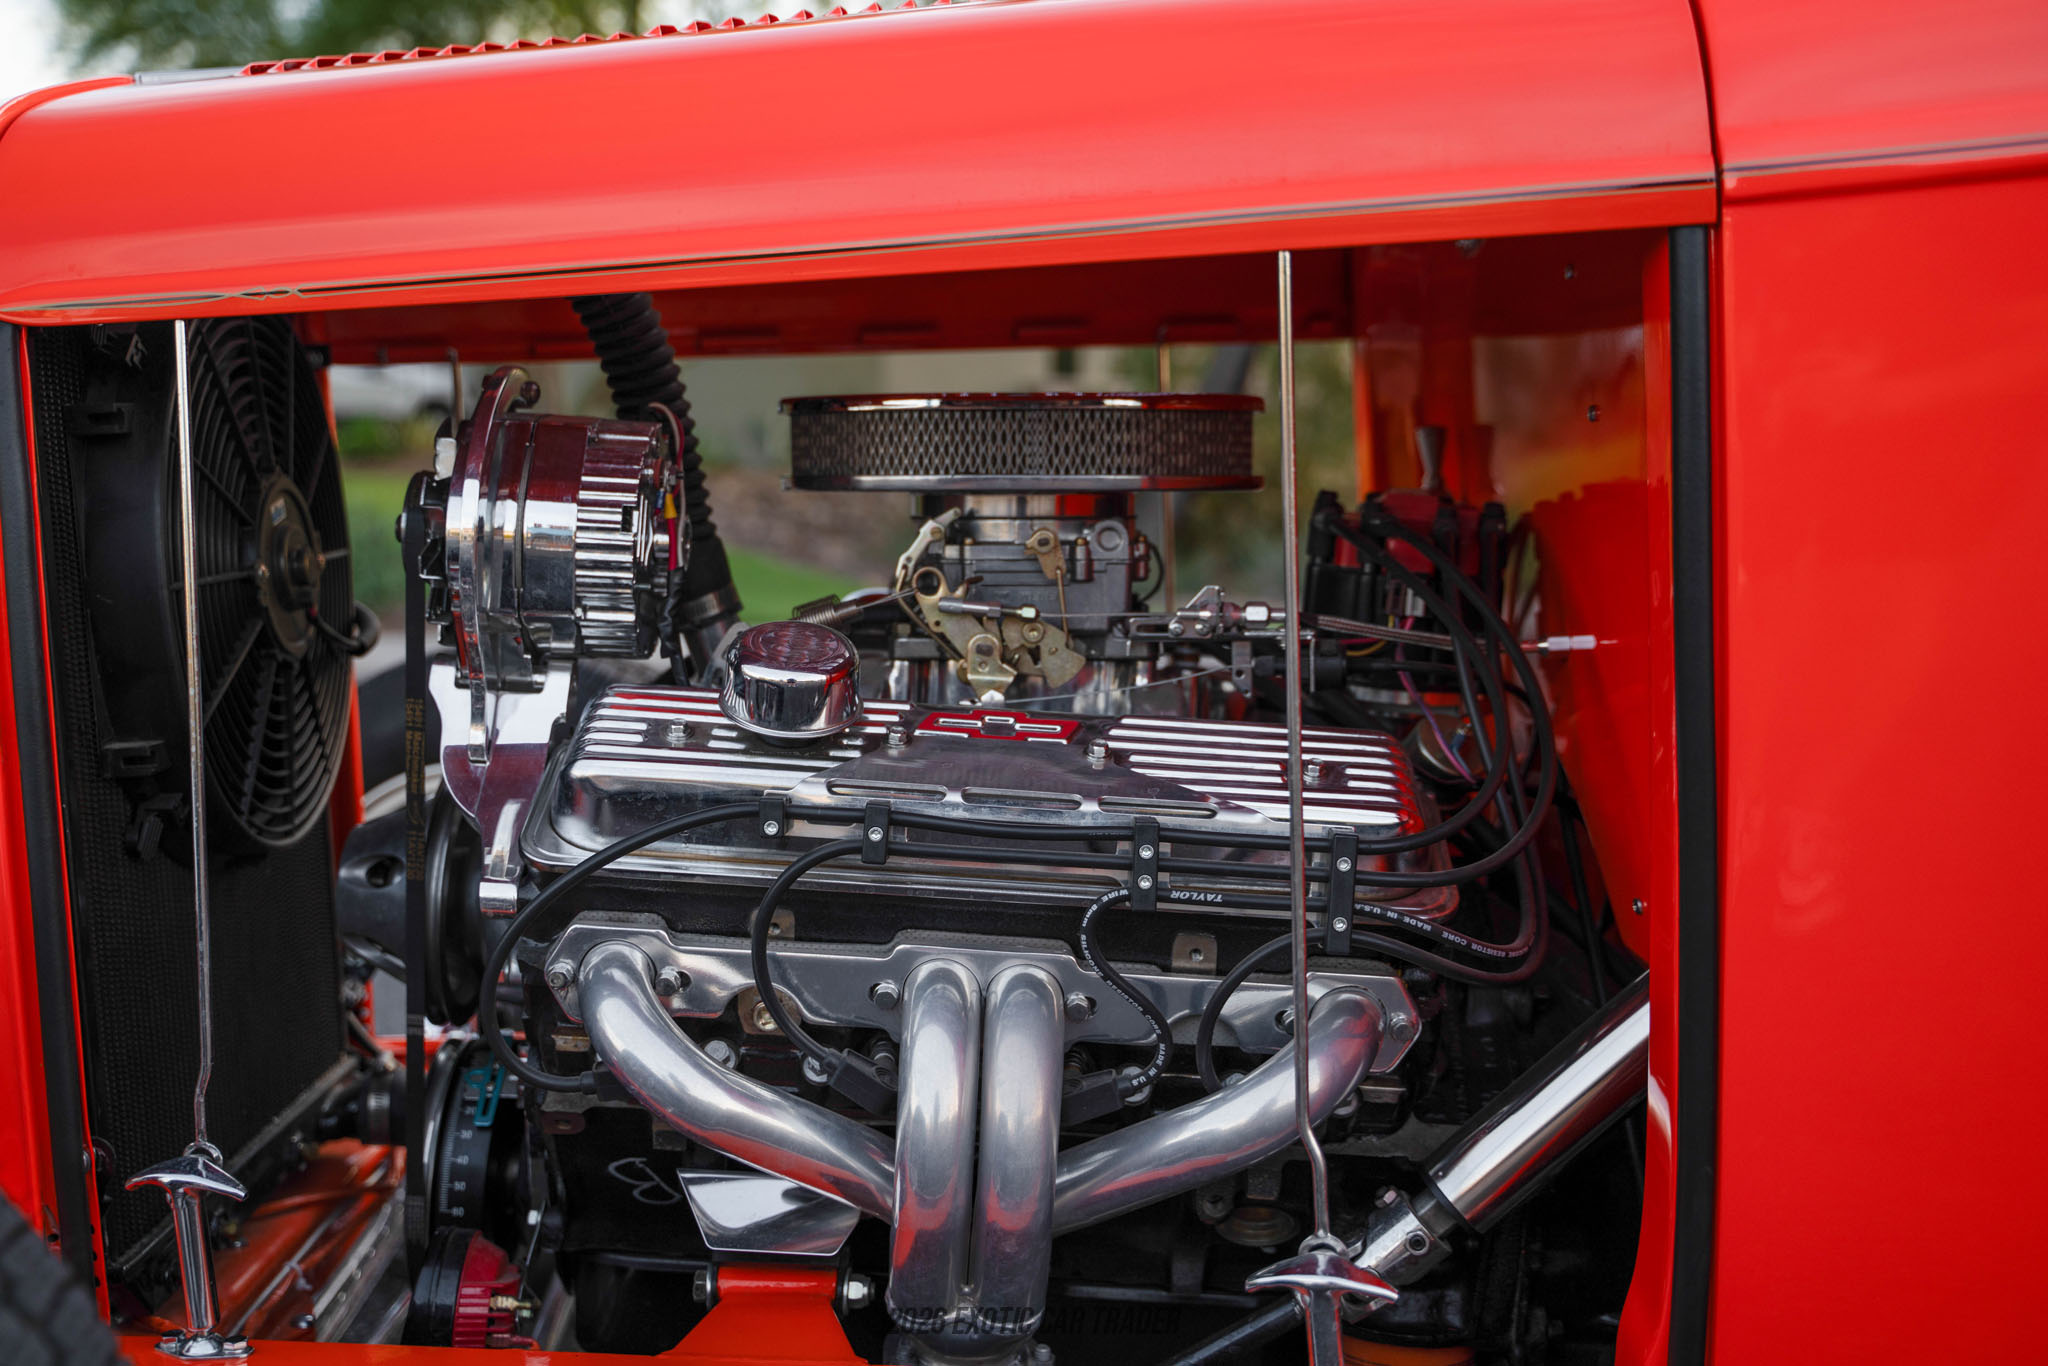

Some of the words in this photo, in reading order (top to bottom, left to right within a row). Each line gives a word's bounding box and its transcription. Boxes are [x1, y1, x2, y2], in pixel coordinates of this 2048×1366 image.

[1101, 889, 1128, 902] WIRE
[1169, 890, 1223, 902] TAYLOR
[1082, 904, 1098, 927] 8mm
[1386, 906, 1398, 919] IN
[1402, 915, 1432, 931] MADE
[1441, 930, 1467, 946] CORE
[1145, 1014, 1162, 1035] CORE
[1155, 1043, 1166, 1067] MADE
[1148, 1067, 1158, 1077] IN
